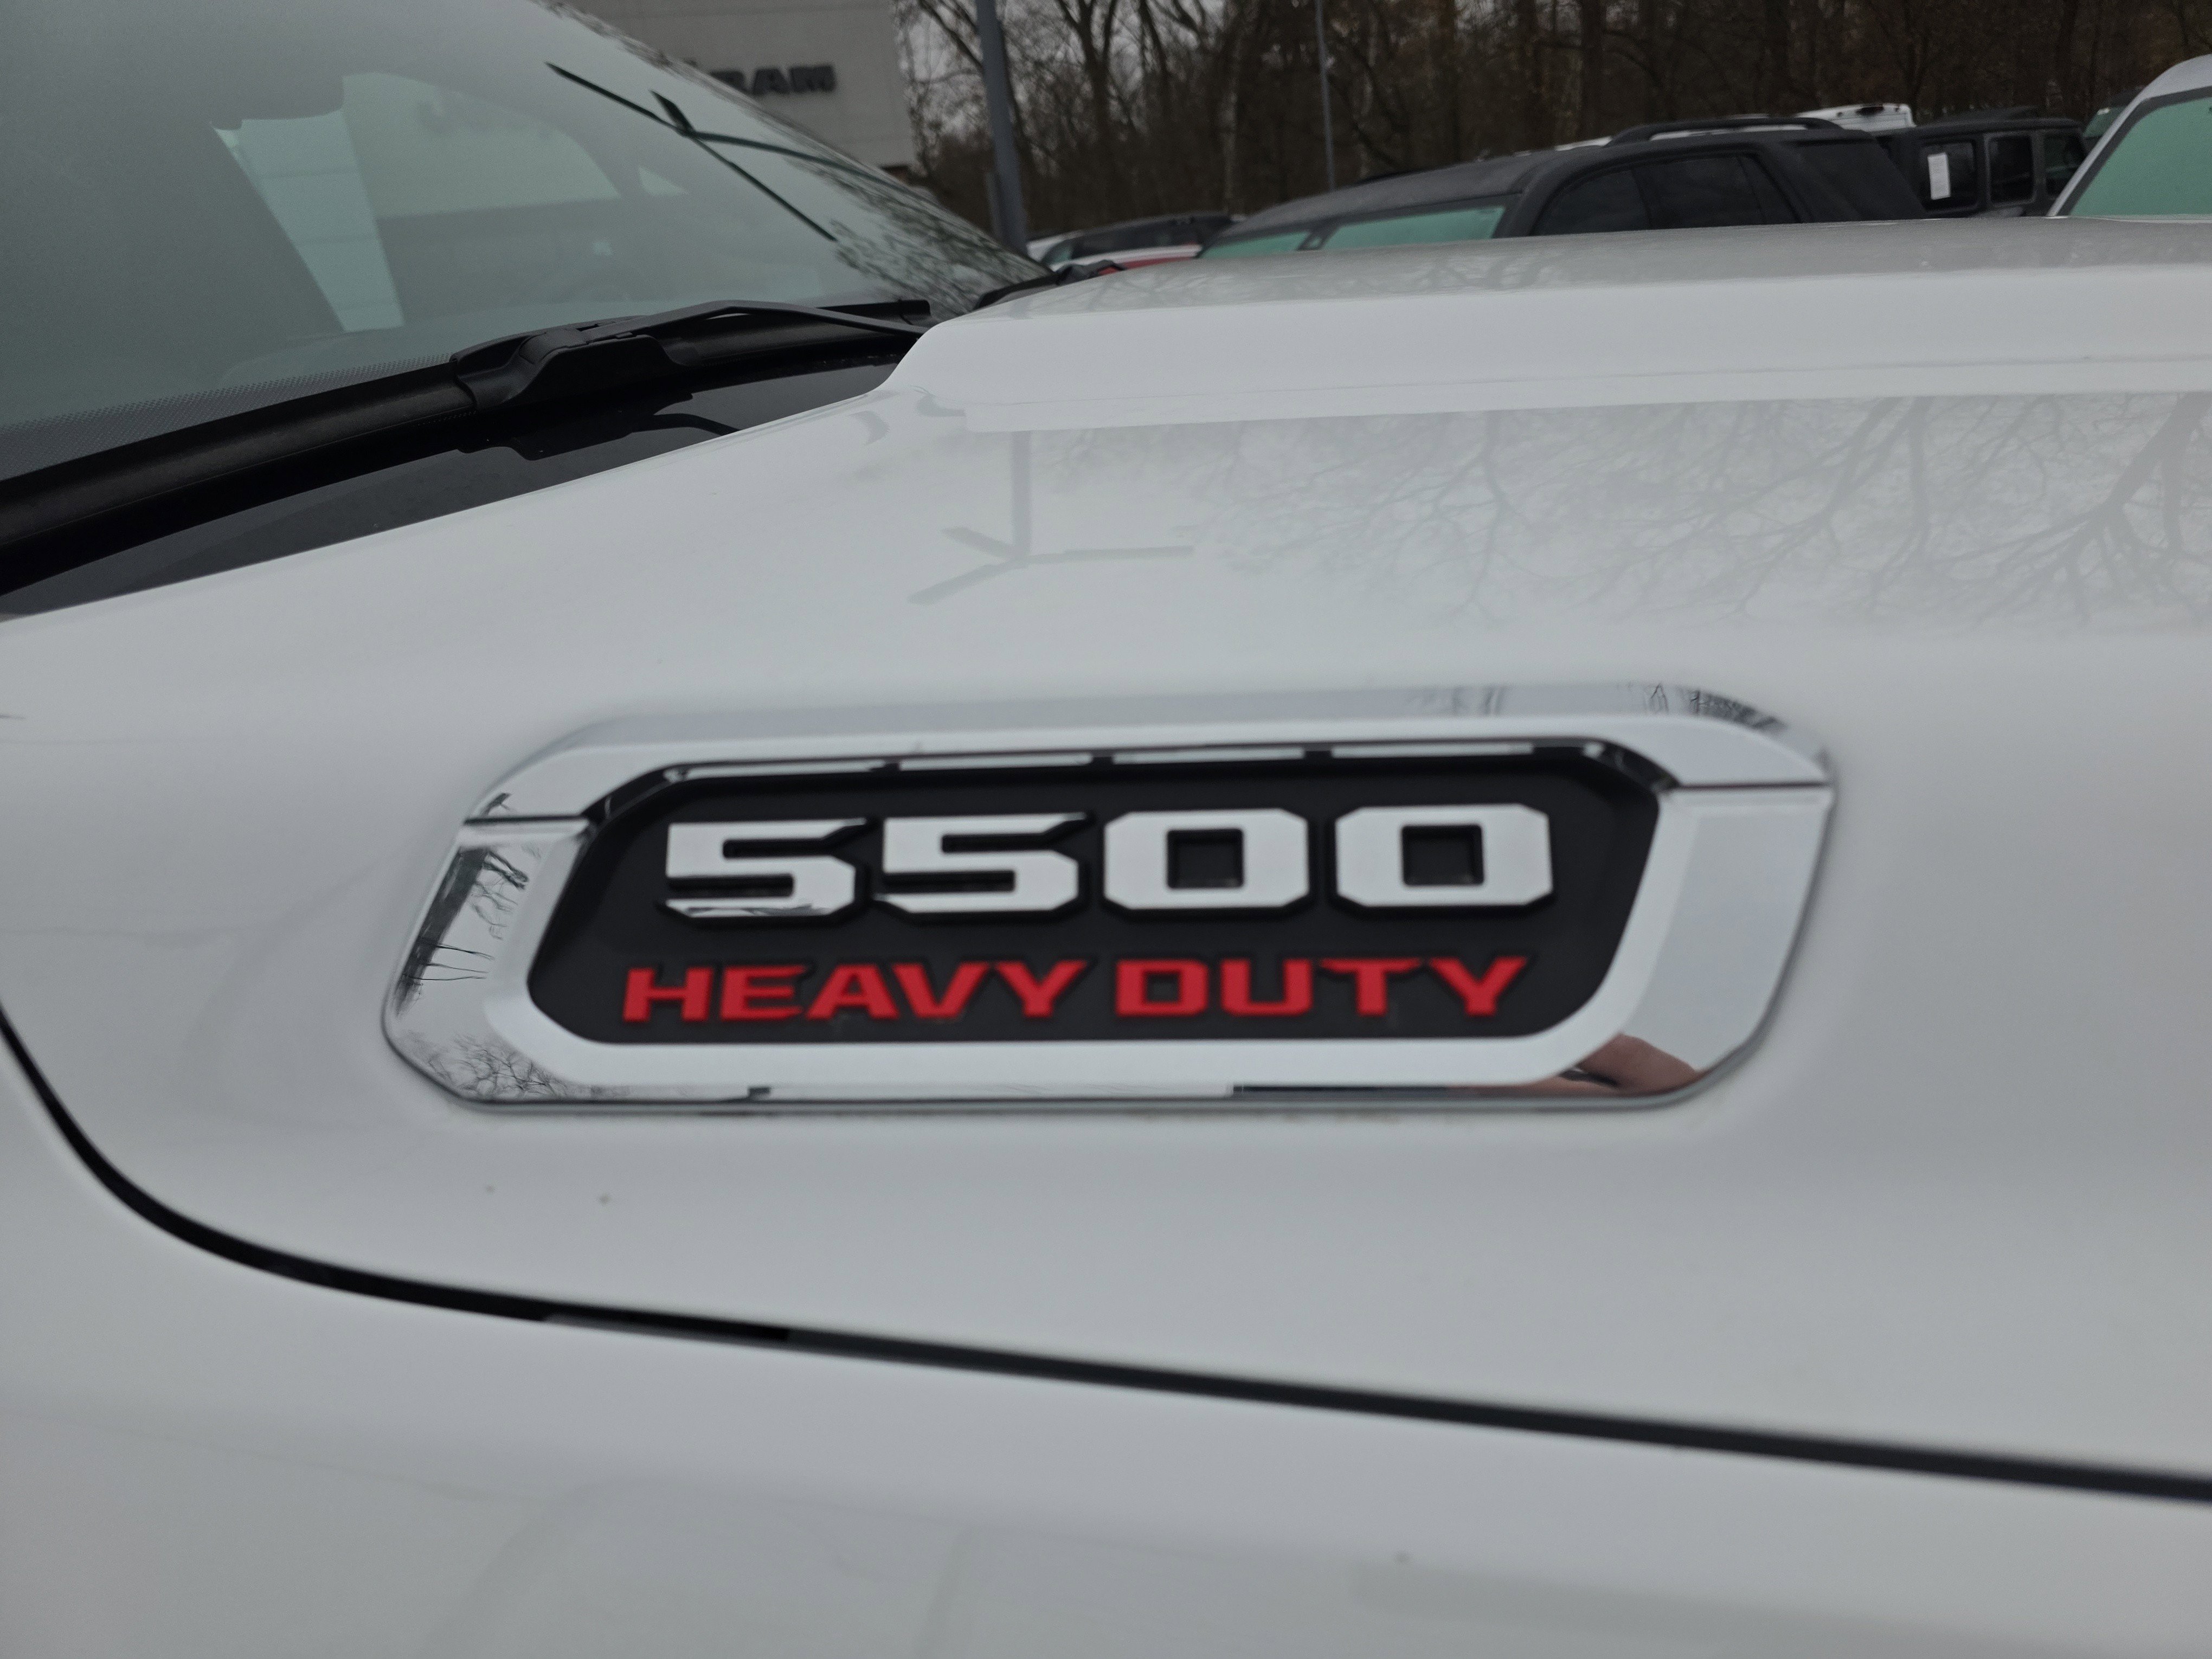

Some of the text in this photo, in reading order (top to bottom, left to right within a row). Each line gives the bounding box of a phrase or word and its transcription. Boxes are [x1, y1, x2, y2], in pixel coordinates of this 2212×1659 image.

[664, 803, 1554, 917] 5500
[622, 956, 1527, 1021] HEAVY DUTY
